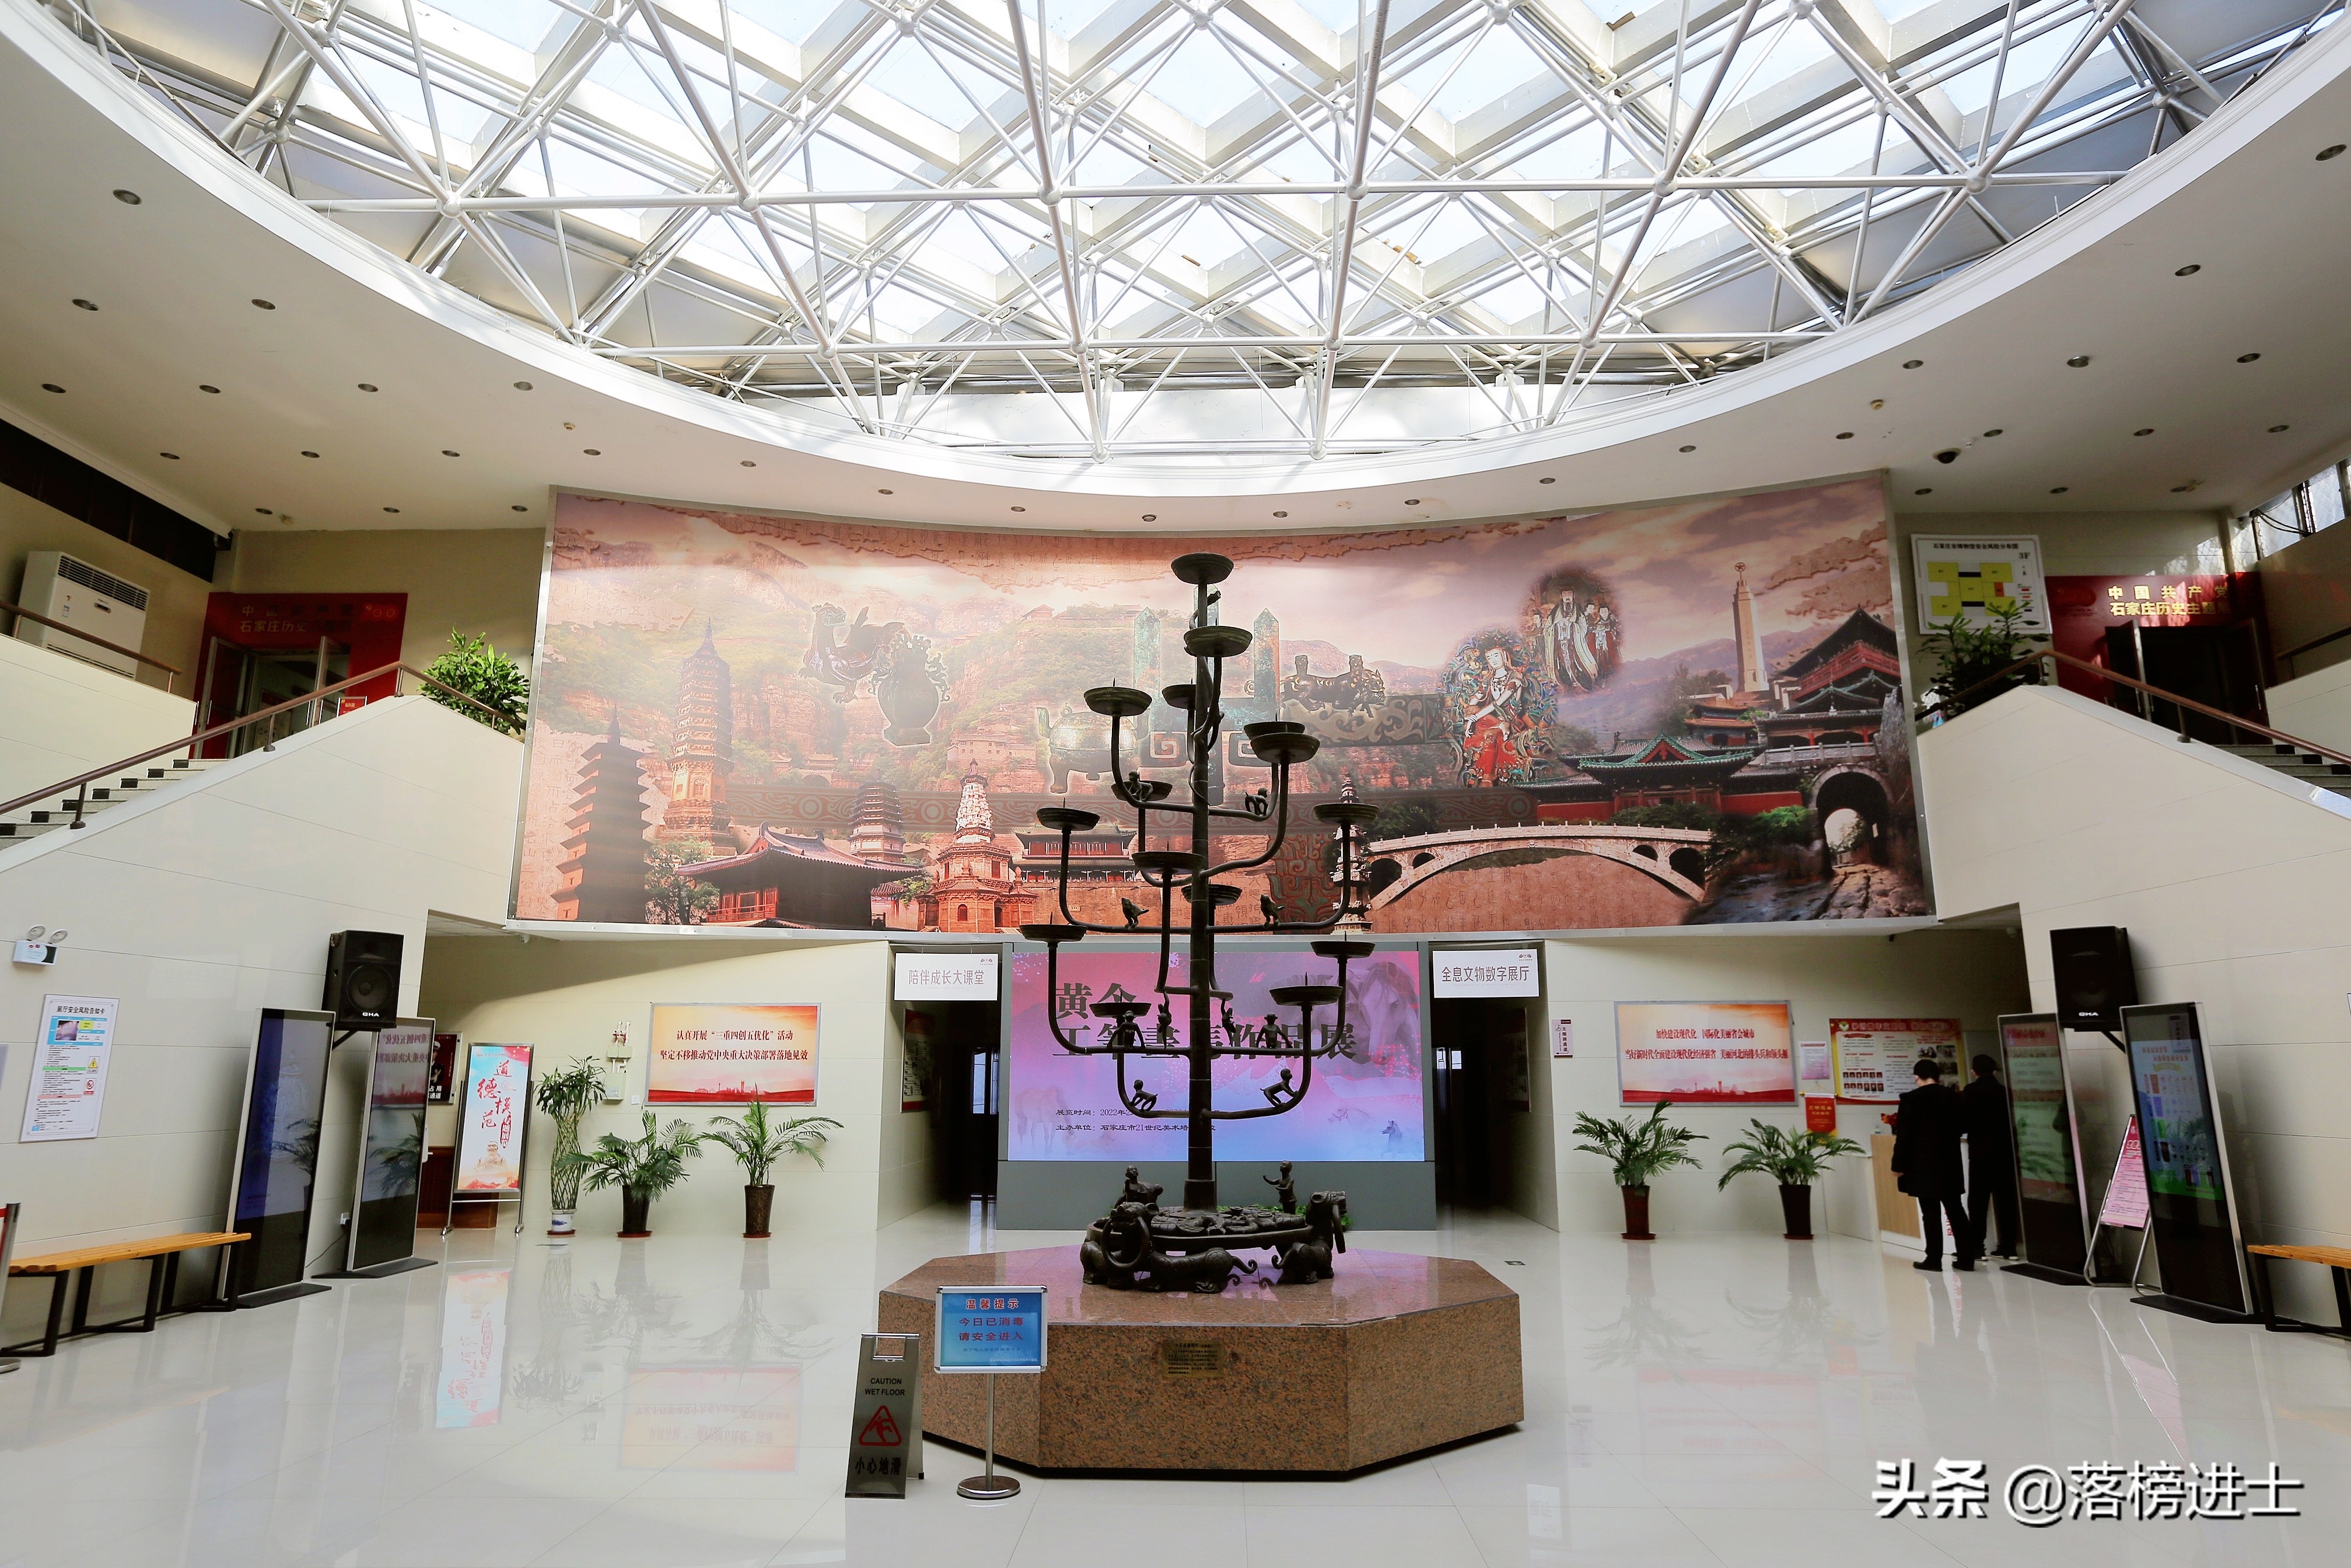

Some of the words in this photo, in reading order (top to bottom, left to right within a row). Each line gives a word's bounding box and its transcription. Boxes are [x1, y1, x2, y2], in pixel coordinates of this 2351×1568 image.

[2107, 584, 2228, 600] 中国共产党
[908, 969, 984, 985] 陪伴成长大课堂
[1442, 966, 1530, 982] 全息文物数字展厅
[56, 1005, 106, 1014] 展厅安全风险告知卡
[659, 1049, 809, 1060] 坚定不移推动党中央重大决策部署落地见效
[965, 1298, 1019, 1310] 温馨提示
[958, 1317, 1024, 1326] 今日已消毒
[958, 1332, 1024, 1342] 请安全进入
[855, 1457, 901, 1476] 小心地滑
